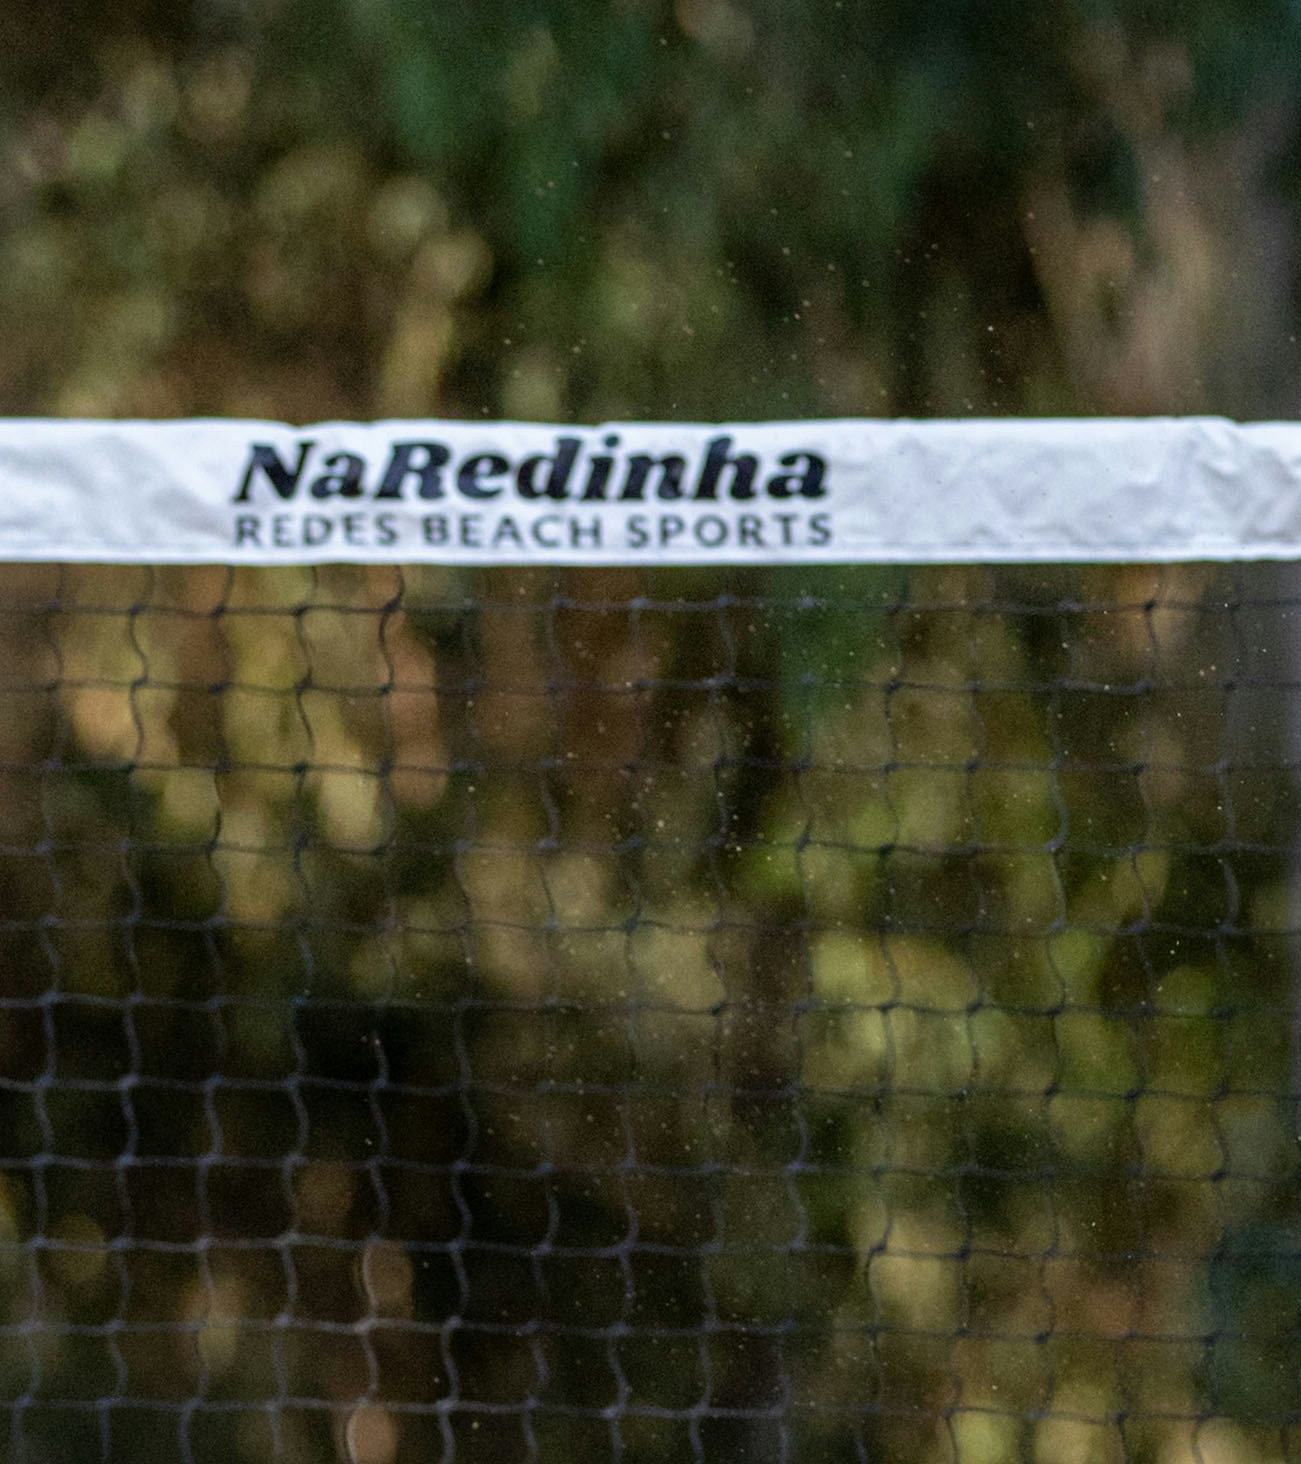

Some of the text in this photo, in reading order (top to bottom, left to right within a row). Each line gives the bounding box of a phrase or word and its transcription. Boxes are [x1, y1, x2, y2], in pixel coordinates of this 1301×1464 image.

[231, 434, 830, 504] NaRedinha
[235, 512, 834, 550] REDES BEACH SPORTS
